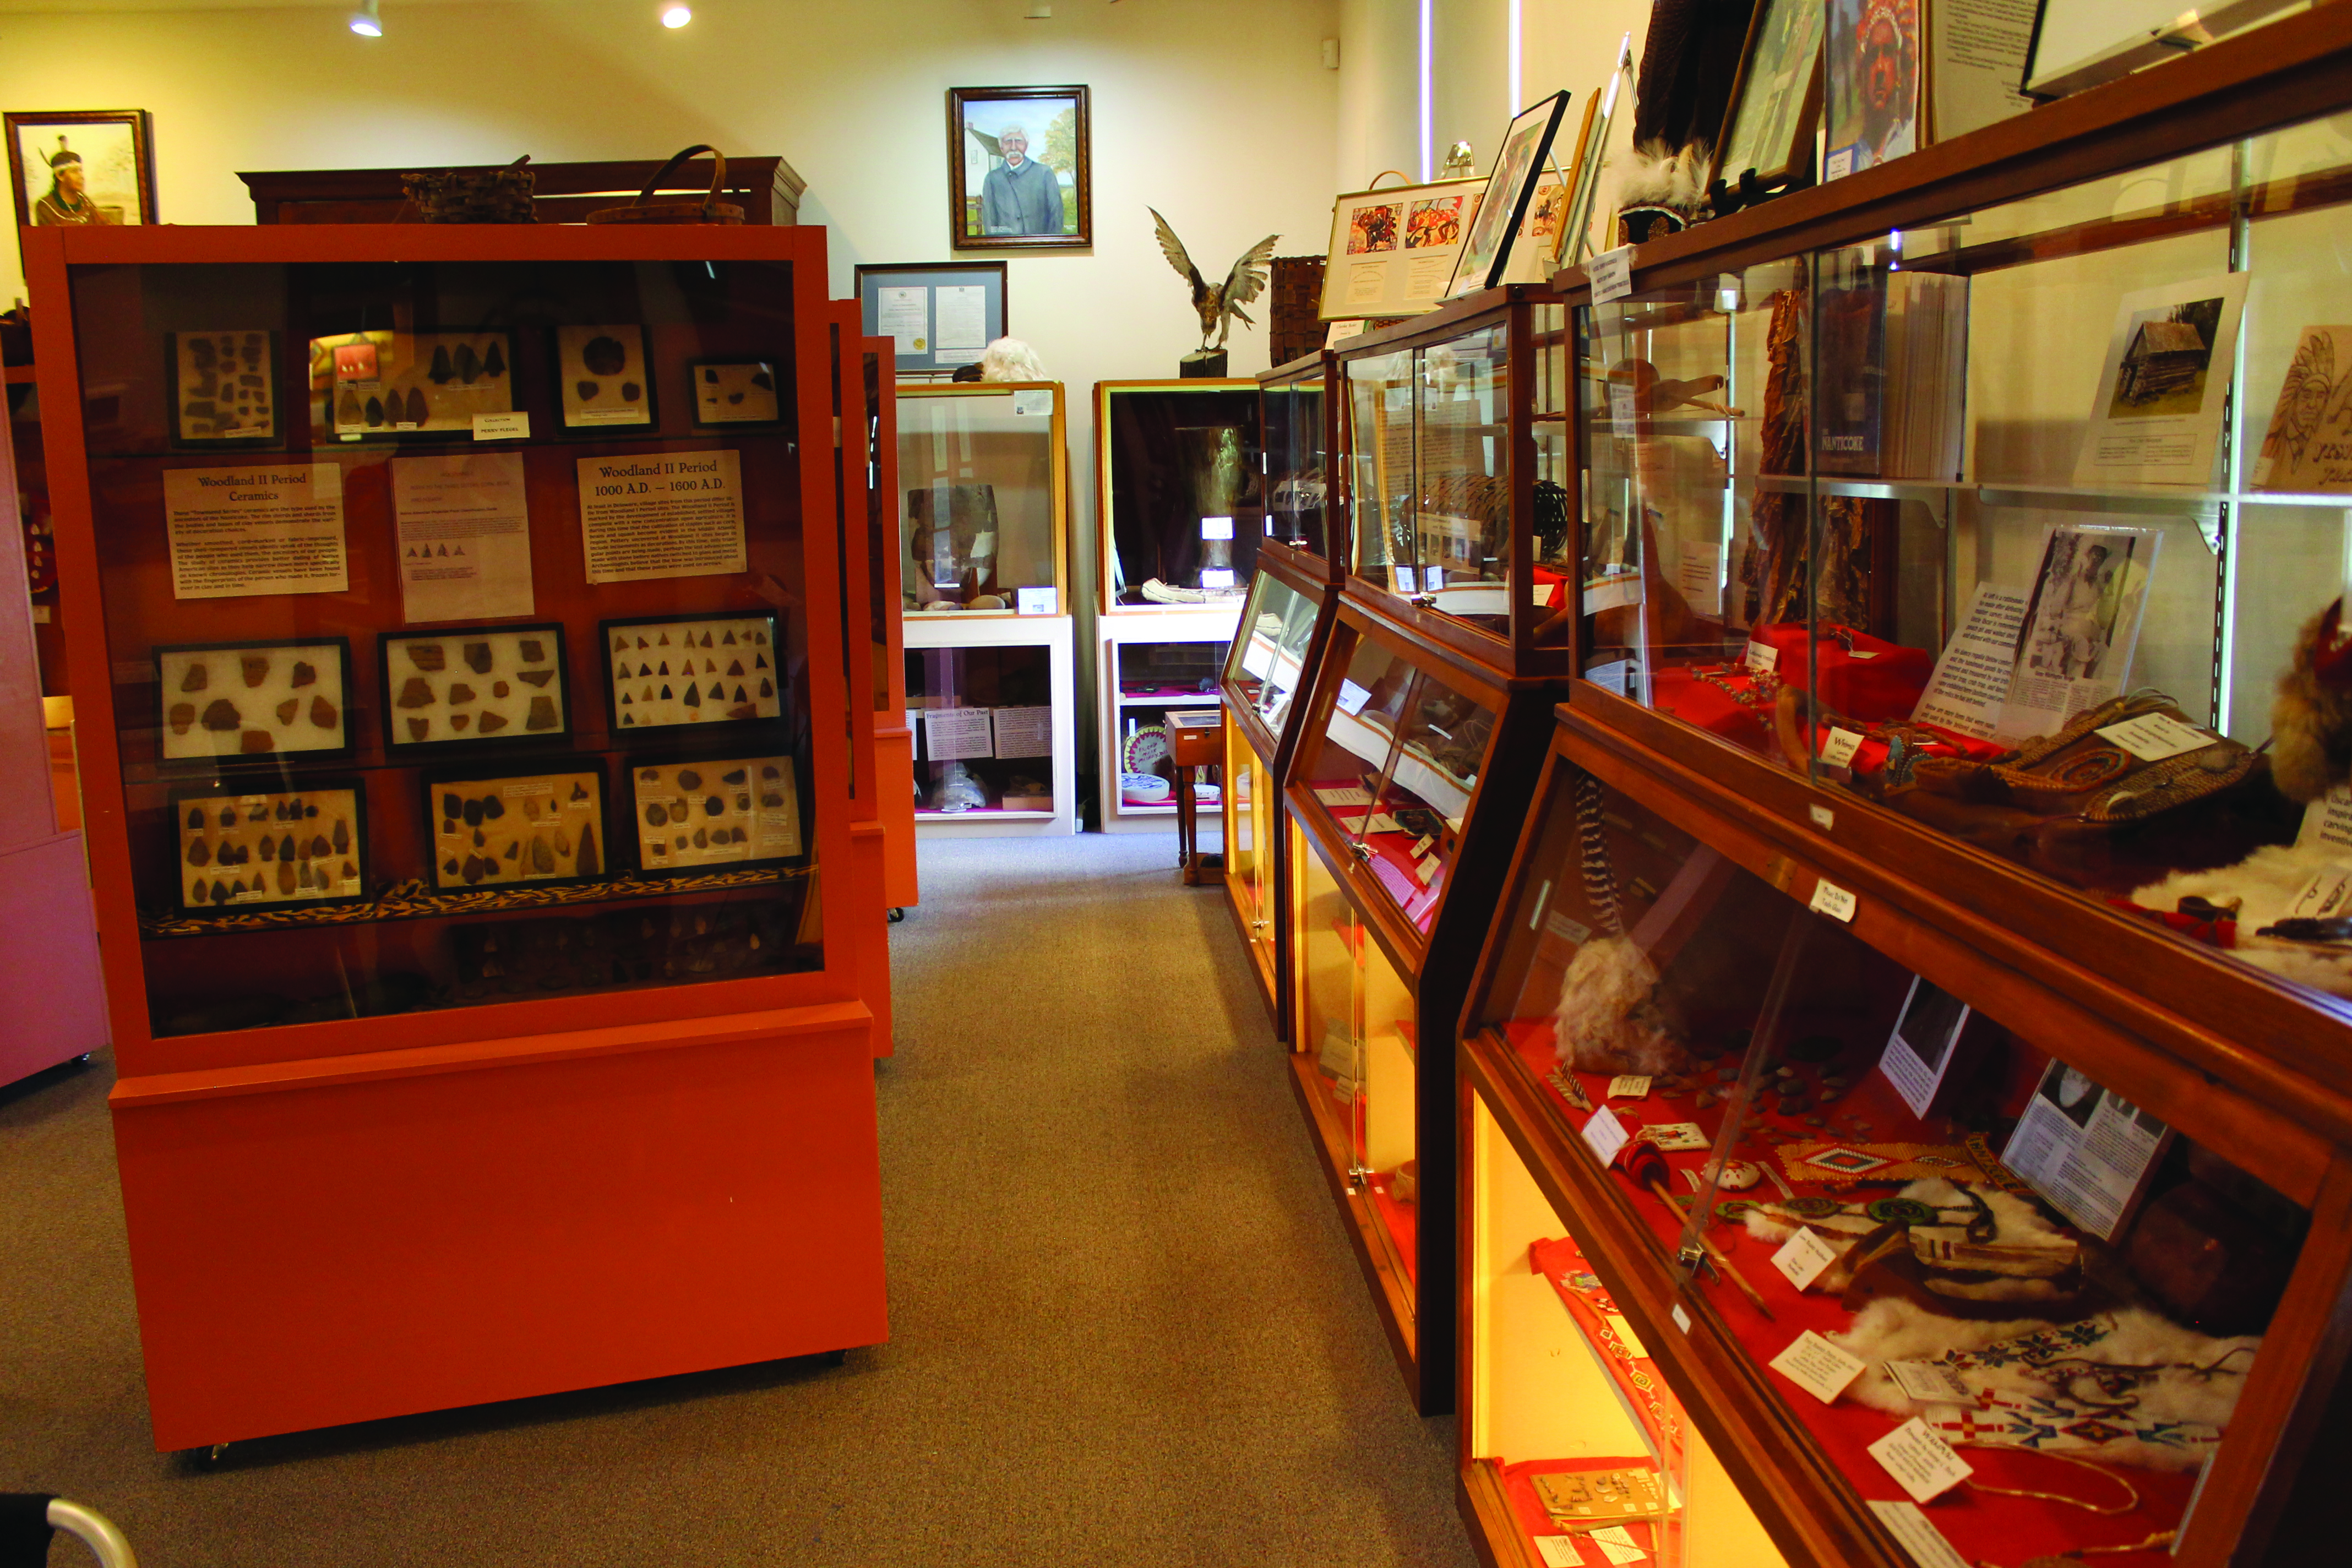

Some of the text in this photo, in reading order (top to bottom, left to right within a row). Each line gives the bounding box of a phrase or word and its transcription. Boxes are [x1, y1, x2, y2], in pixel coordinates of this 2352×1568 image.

[1822, 436, 1864, 451] NANTICOKE
[598, 460, 717, 477] Woodland II Period
[197, 472, 306, 487] Woodland II Period
[595, 485, 623, 496] 1000
[627, 482, 651, 494] A.D.
[670, 481, 698, 491] 1600
[701, 478, 725, 489] A.D.
[228, 491, 279, 501] Ceramics
